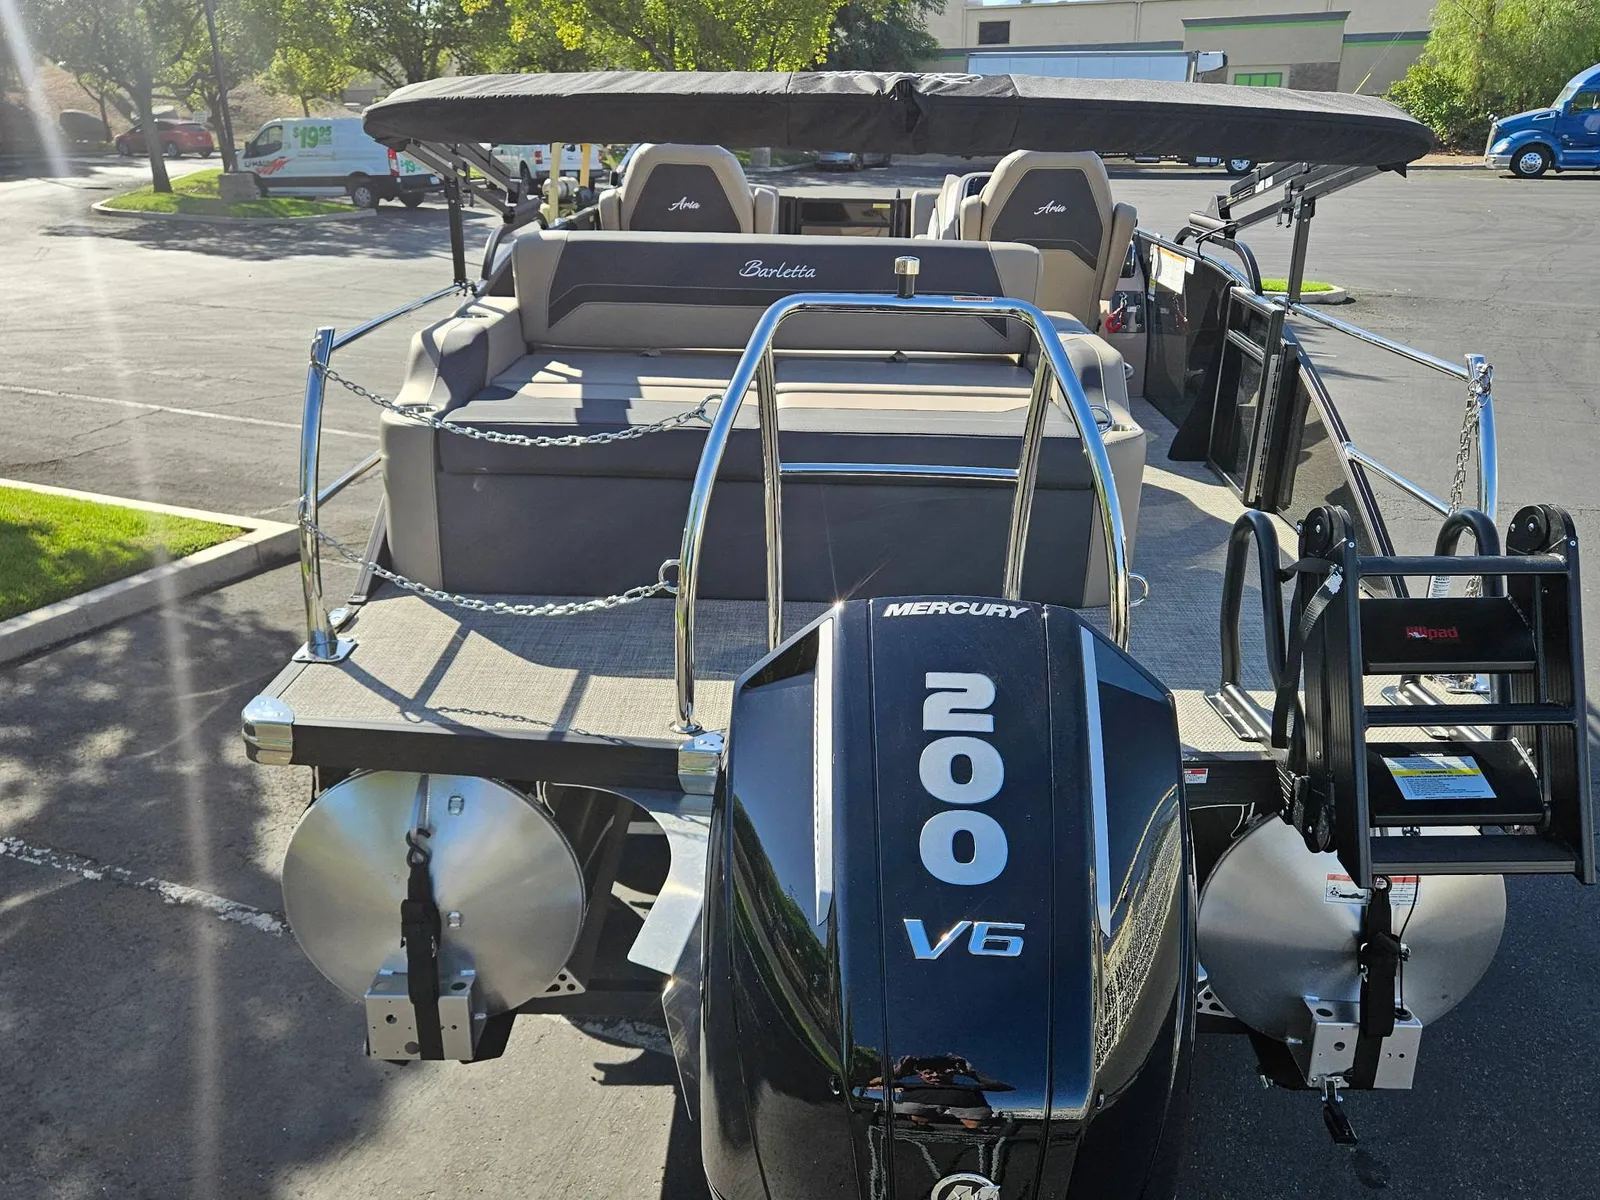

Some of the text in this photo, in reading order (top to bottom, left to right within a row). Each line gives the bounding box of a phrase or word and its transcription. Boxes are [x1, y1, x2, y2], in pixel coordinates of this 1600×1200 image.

[667, 196, 700, 211] Aria
[1033, 200, 1067, 215] Aria
[739, 259, 816, 278] Barletta
[883, 601, 1030, 619] MERCURY
[918, 671, 1008, 886] 200
[903, 918, 1026, 960] V6
